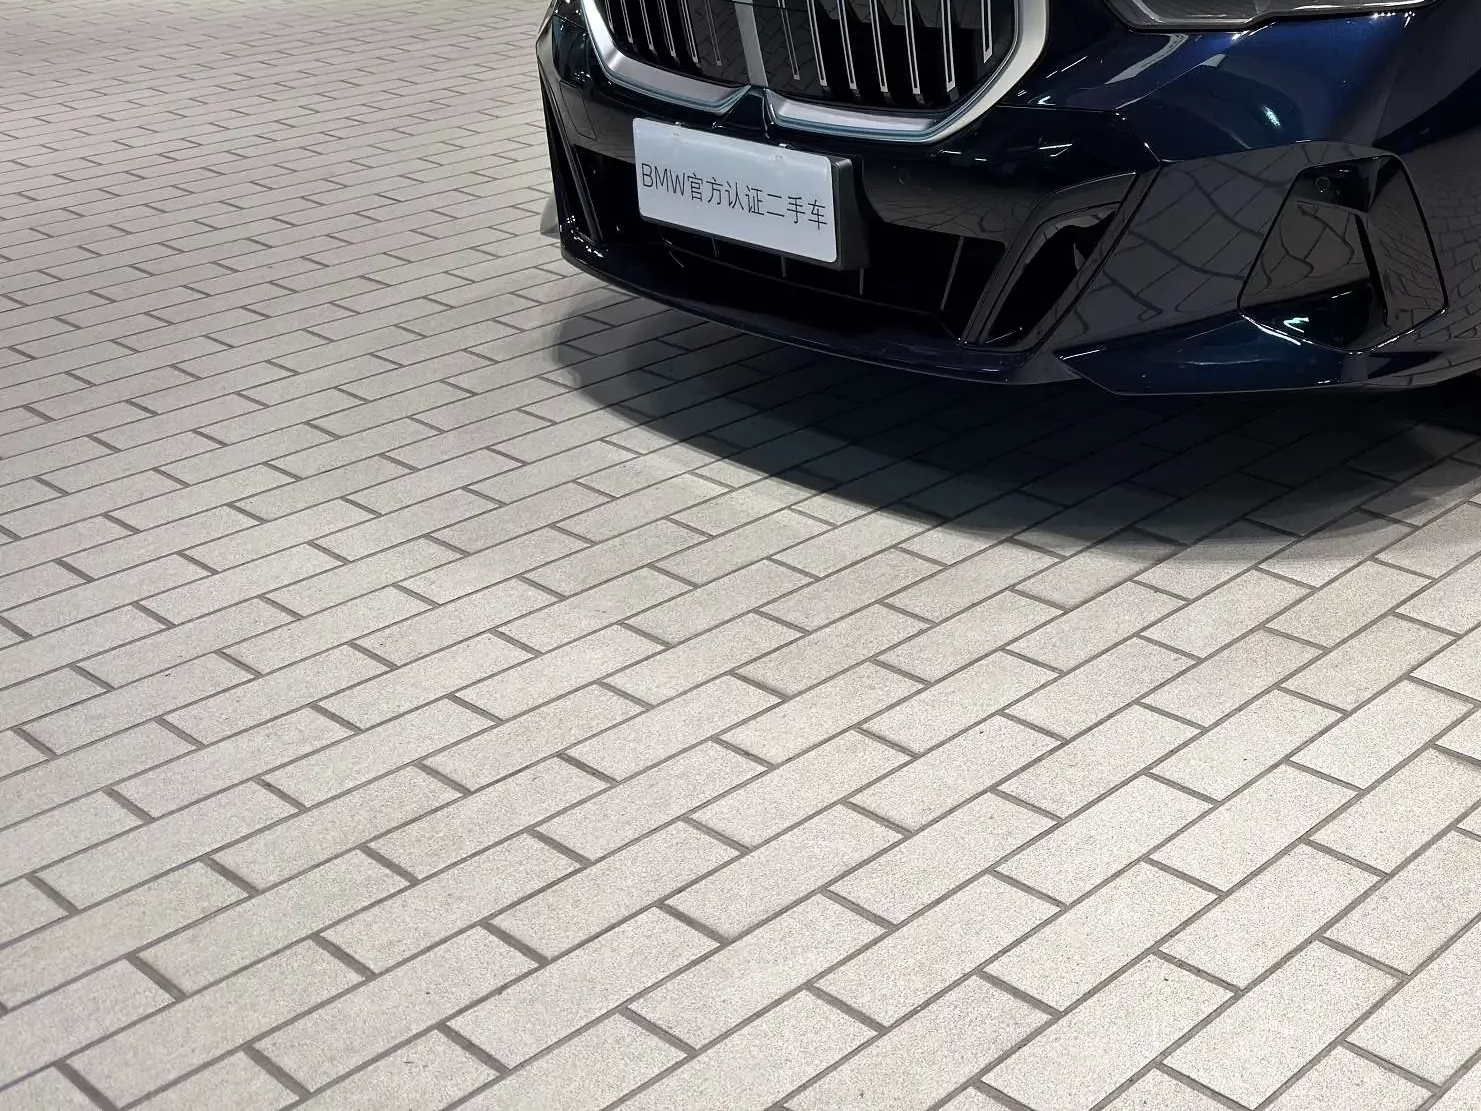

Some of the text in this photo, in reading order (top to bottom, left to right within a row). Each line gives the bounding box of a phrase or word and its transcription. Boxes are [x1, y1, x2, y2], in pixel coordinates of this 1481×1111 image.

[641, 163, 829, 231] BMW官方认证二手车
